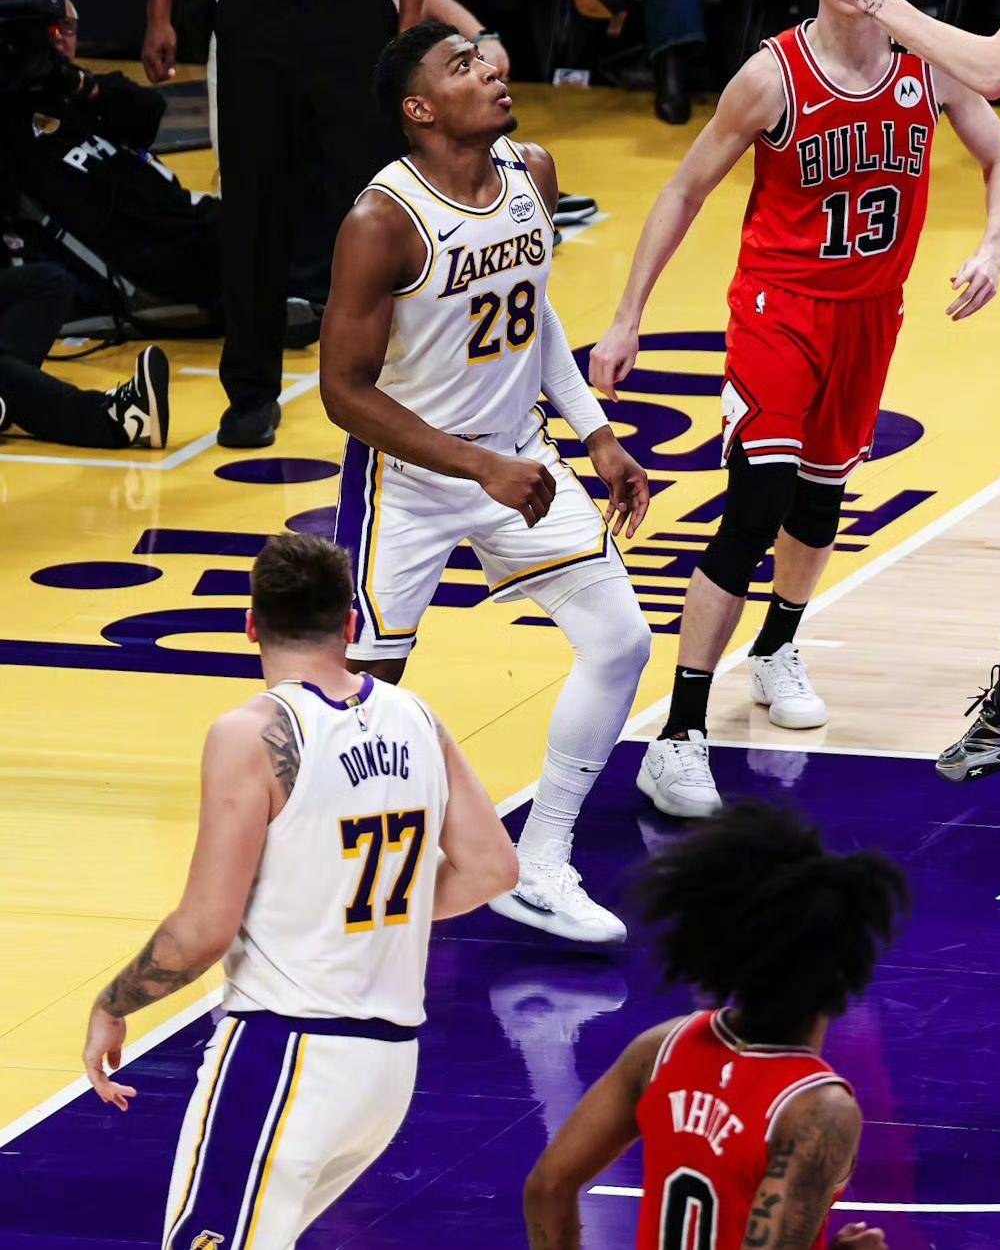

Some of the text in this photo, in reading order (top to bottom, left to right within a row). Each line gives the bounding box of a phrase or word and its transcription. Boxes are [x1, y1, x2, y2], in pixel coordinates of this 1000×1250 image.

[797, 120, 928, 188] BULLS
[819, 185, 900, 259] 13
[436, 227, 546, 300] LAKERS
[466, 278, 537, 367] 28
[337, 807, 428, 934] 77
